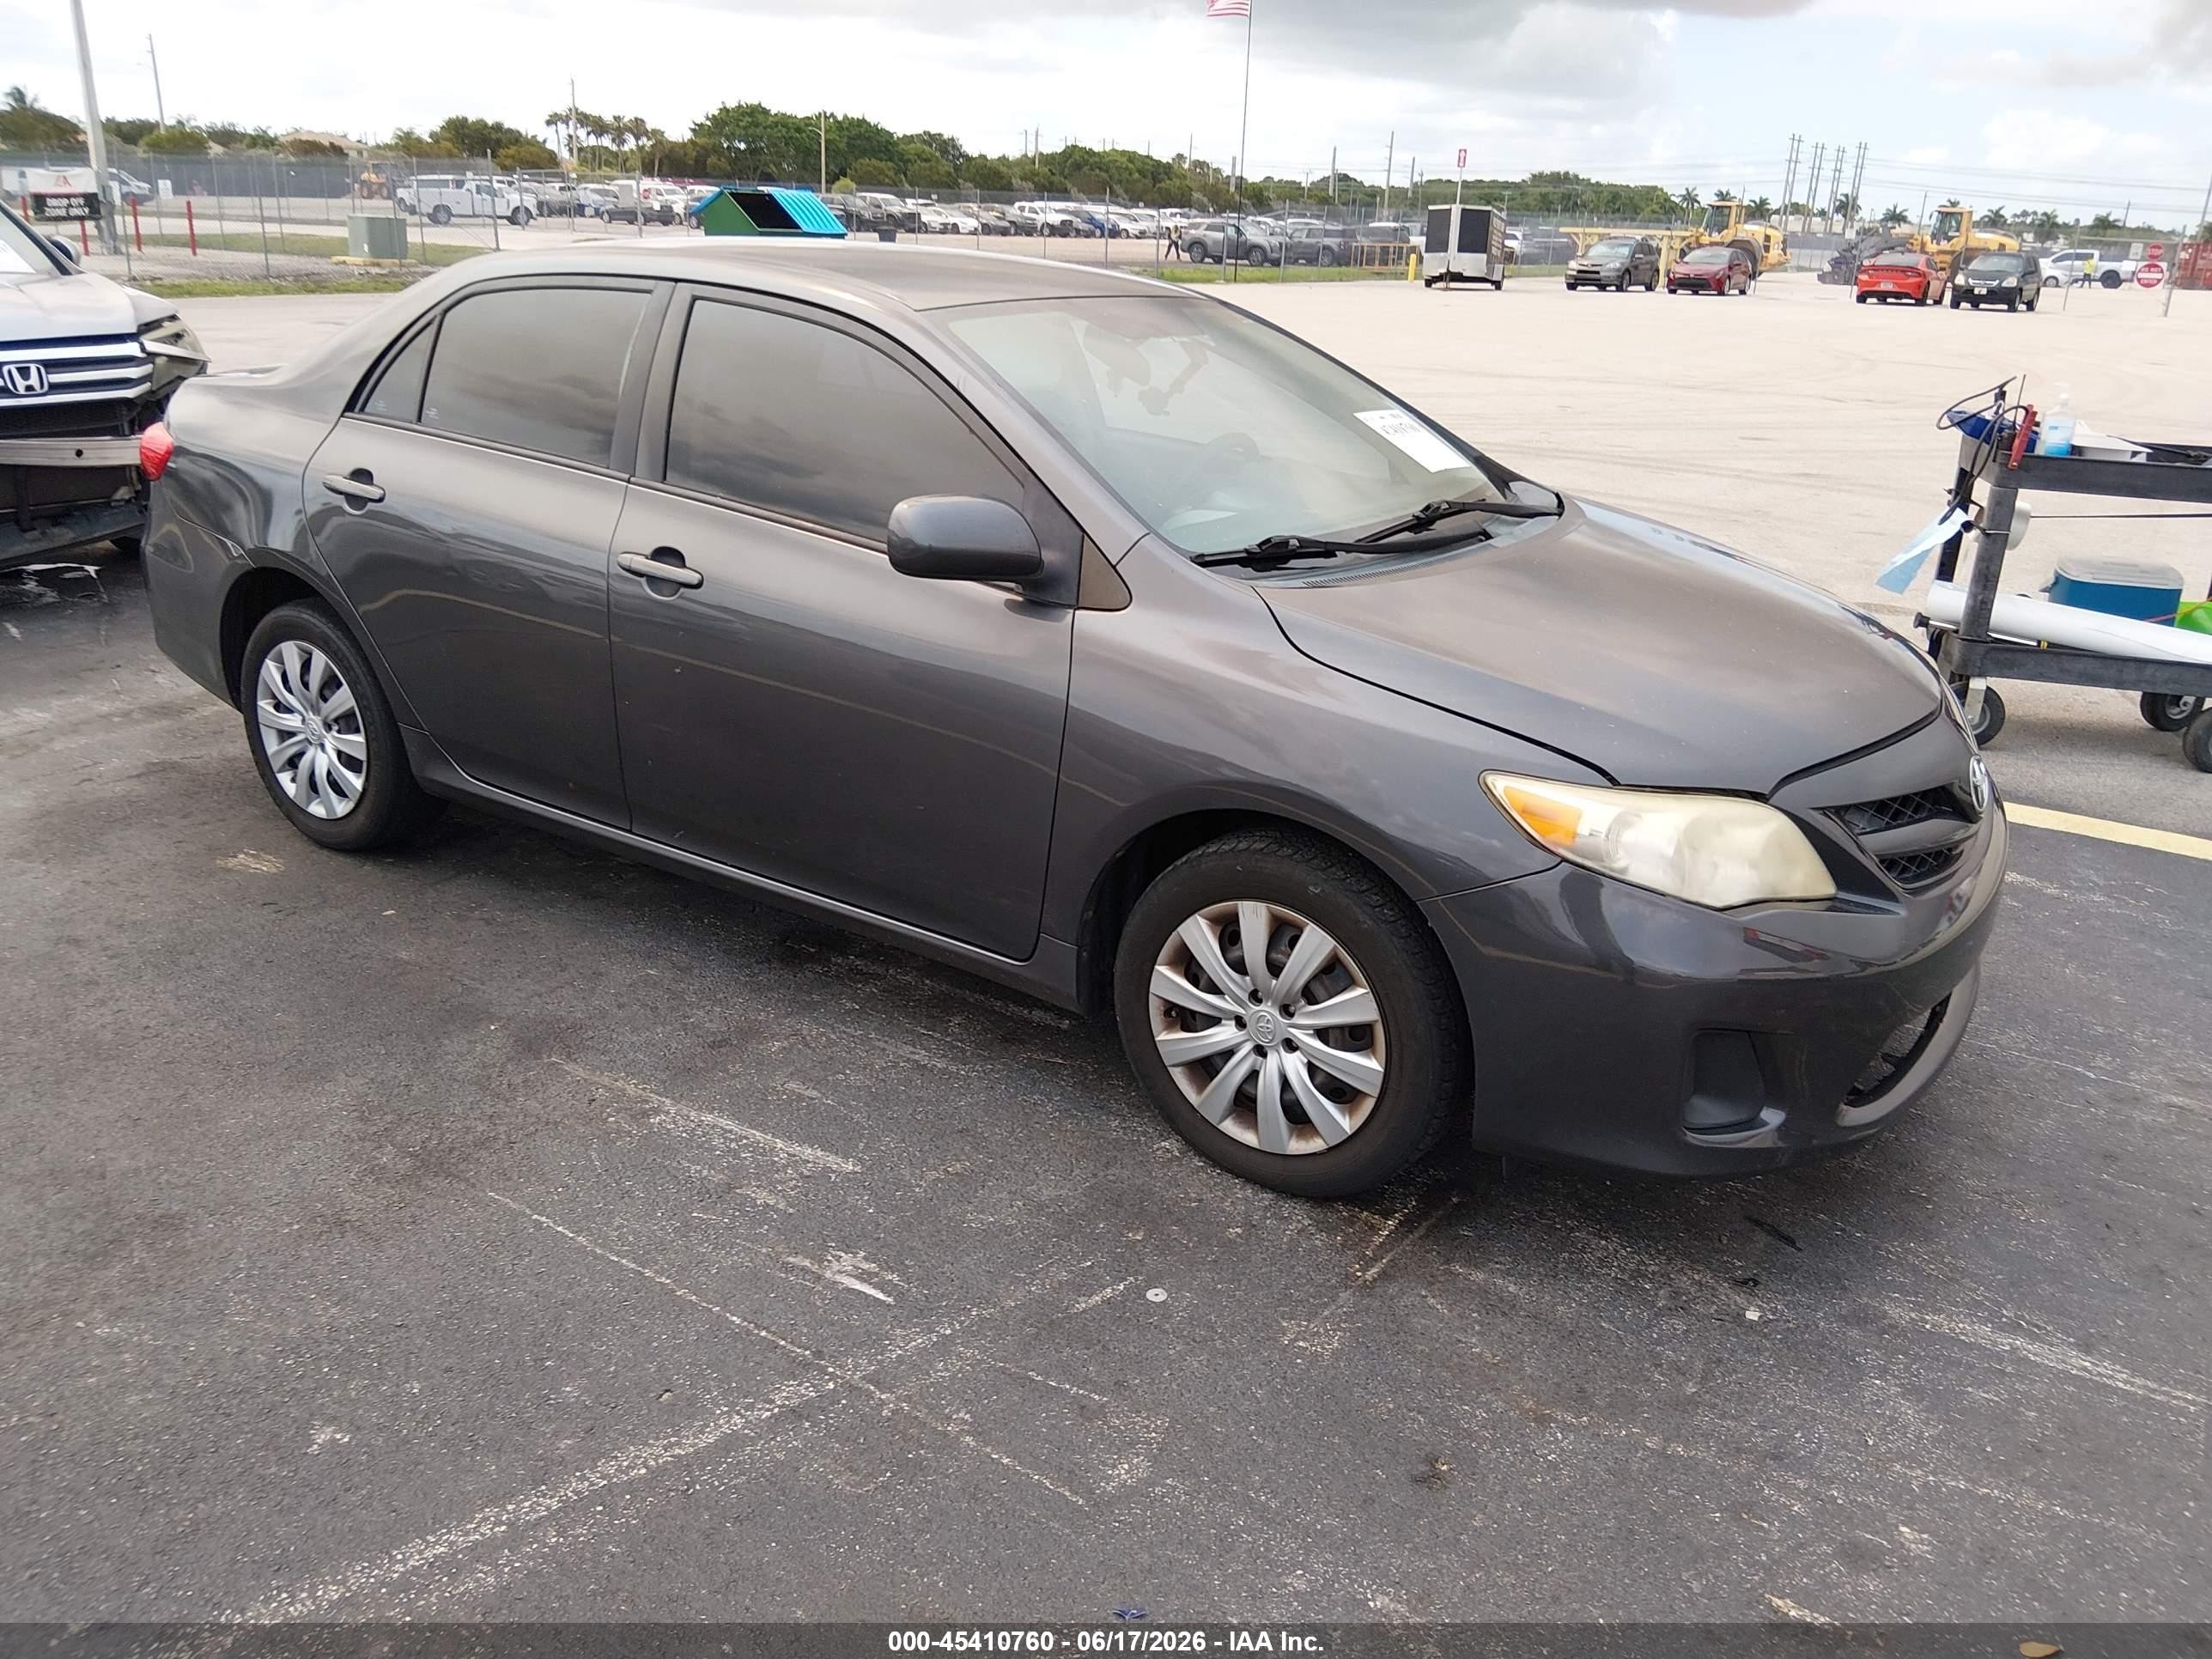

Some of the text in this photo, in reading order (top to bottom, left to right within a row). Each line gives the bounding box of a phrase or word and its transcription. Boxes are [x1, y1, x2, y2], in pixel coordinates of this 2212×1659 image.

[46, 198, 70, 207] DROP
[44, 207, 89, 216] ZONE ONLY
[2148, 247, 2163, 256] STOP
